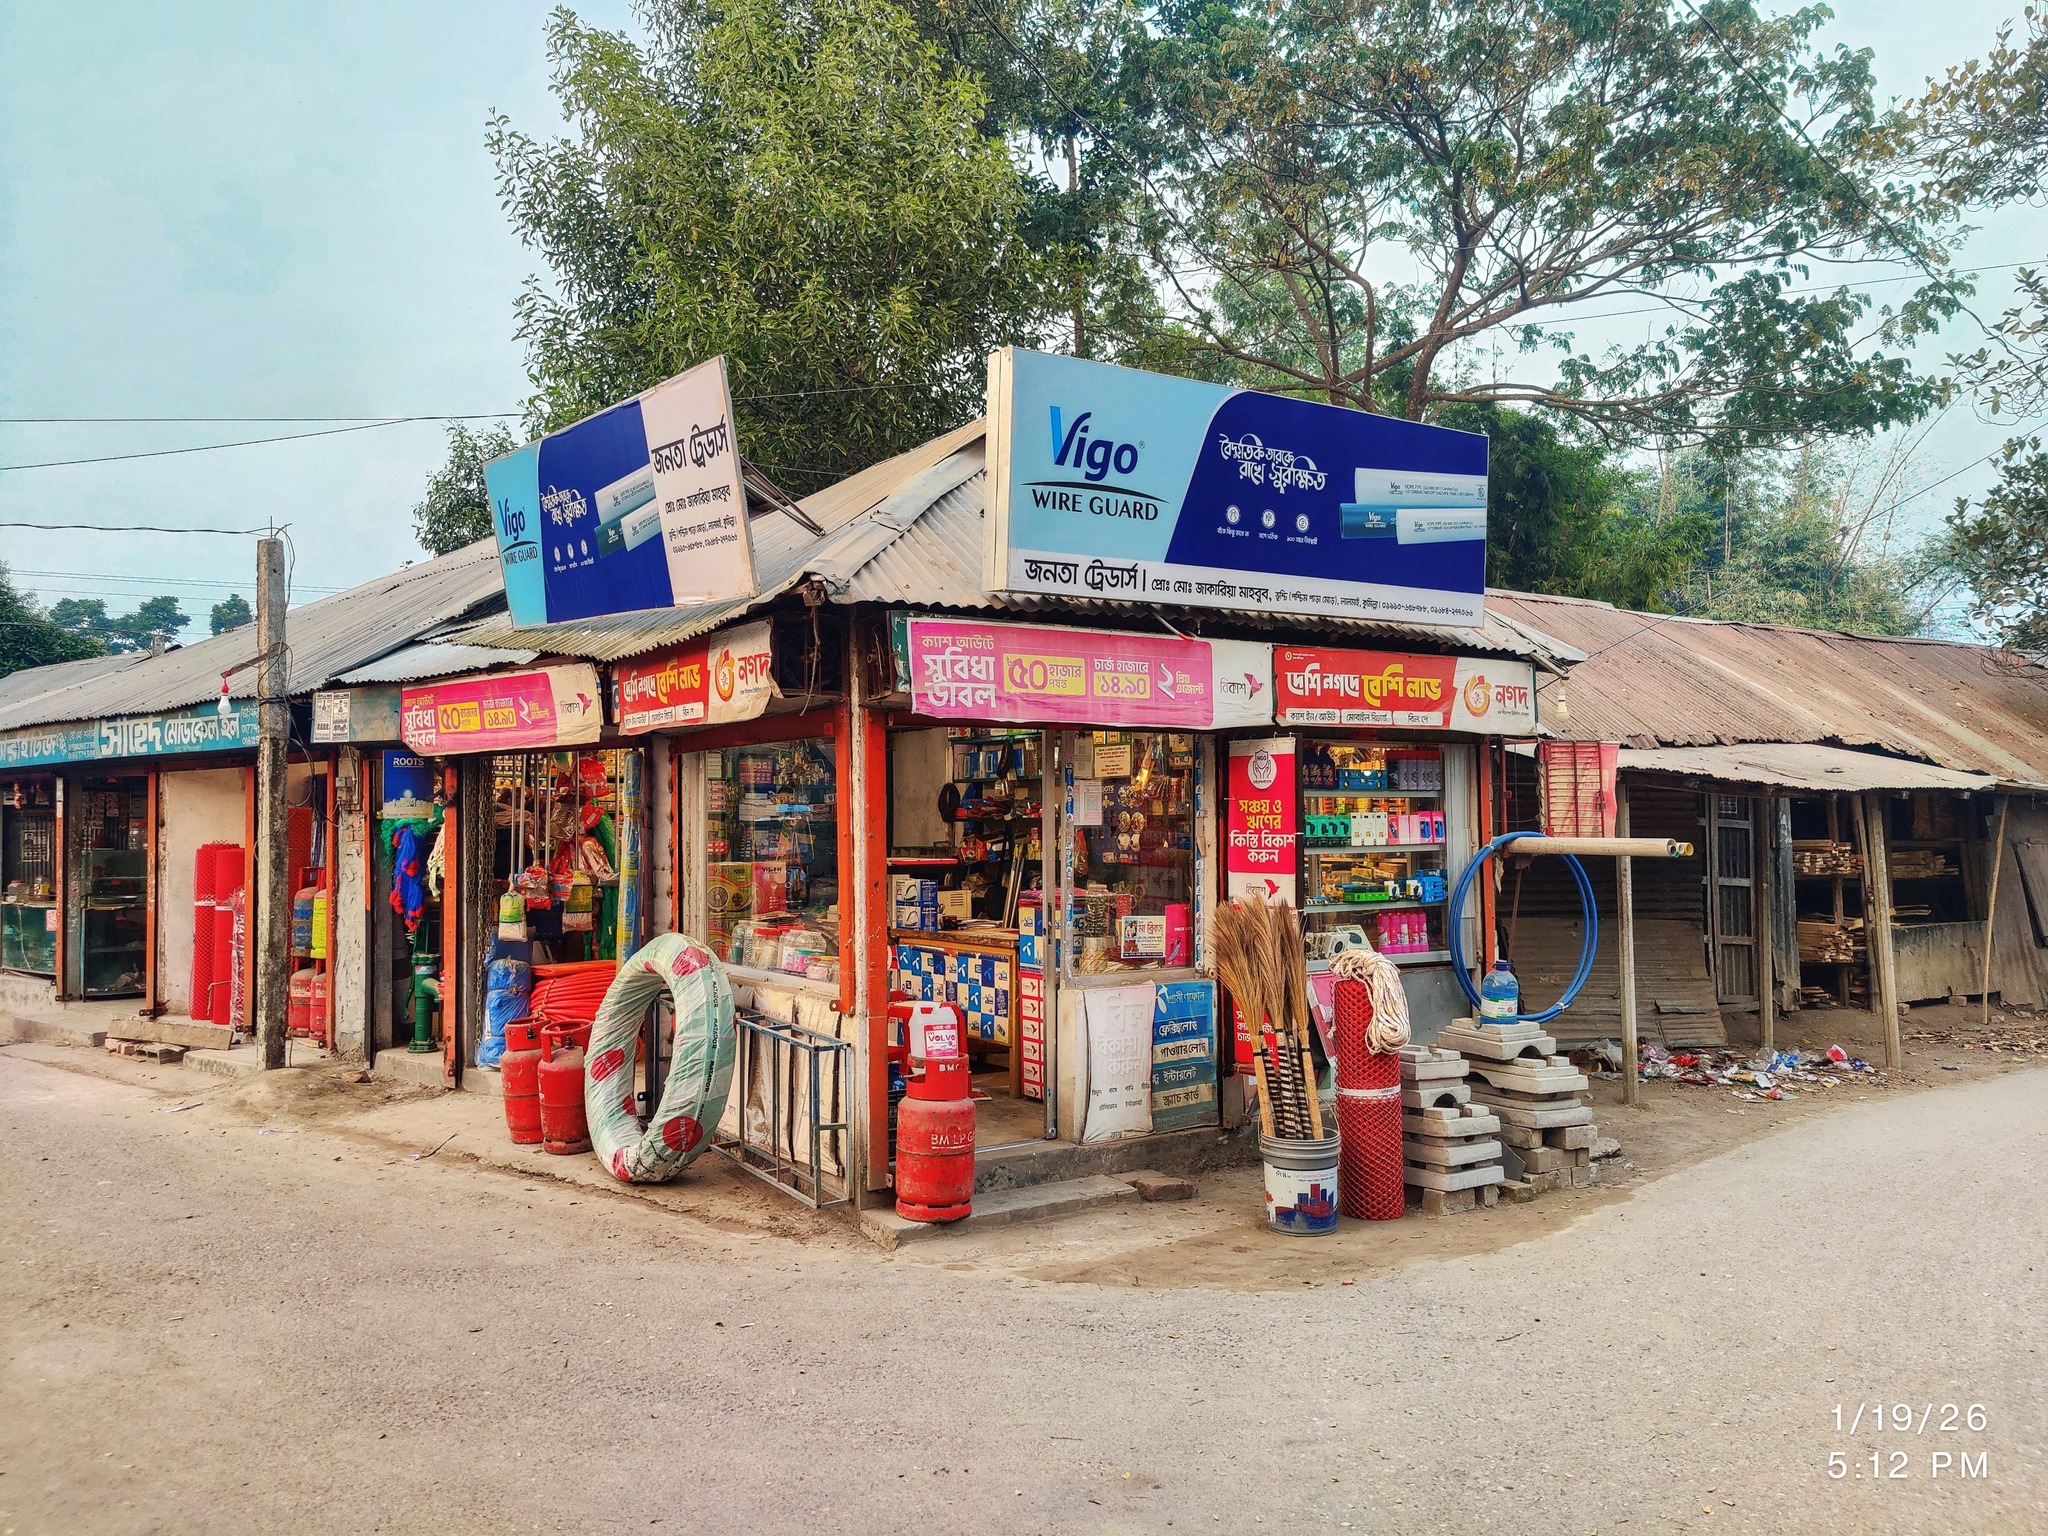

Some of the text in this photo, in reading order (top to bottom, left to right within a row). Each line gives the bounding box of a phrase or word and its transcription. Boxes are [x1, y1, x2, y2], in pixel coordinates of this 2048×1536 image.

[651, 413, 729, 475] জনতা ট্রেডার্স
[1050, 405, 1139, 482] Vigo
[1219, 433, 1294, 467] বৈদ্যুতিক তারকে
[1238, 455, 1328, 494] রাখে সুরক্ষিত
[1032, 489, 1159, 521] WIRE GUARD
[498, 497, 526, 541] Vigo
[504, 547, 538, 566] WIRE GUARD
[1024, 558, 1079, 585] জনতা
[1084, 559, 1139, 591] ট্রেডার্স
[1195, 580, 1237, 599] জাকারিয়া
[921, 634, 994, 649] ক্যাশ আউটে
[737, 652, 772, 685] নগদ
[922, 646, 995, 683] সুবিধা
[1049, 663, 1082, 678] হাজার
[1093, 658, 1149, 674] চার্জ হাজারে
[656, 656, 679, 704] বেশি
[679, 664, 701, 690] লাভ
[1157, 663, 1175, 700] ২
[1175, 671, 1190, 685] প্রিয়
[1220, 678, 1247, 695] বিকাশ
[1285, 662, 1442, 707] দেশি নগদে বেশি লাভ
[924, 682, 997, 708] ডাবল
[1175, 683, 1204, 695] এজেন্টে
[1495, 684, 1529, 710] নগদ
[518, 696, 532, 725] ২
[560, 699, 580, 715] বিকাশ
[1290, 711, 1305, 721] ক্যাশ
[404, 704, 435, 732] সুবিধা
[1346, 711, 1370, 722] মোবাইল
[1407, 713, 1419, 723] বিল
[101, 715, 162, 756] সাহেদ
[164, 711, 219, 746] মেডিকেল
[219, 713, 240, 741] হল
[393, 757, 425, 766] ROOTS
[1238, 799, 1283, 814] সঞ্চয় ও
[1246, 814, 1283, 830] ঋণের
[1229, 829, 1296, 849] কিস্তি বিকাশ
[1247, 849, 1279, 863] করুন
[1138, 924, 1146, 933] মা
[1168, 991, 1205, 1005] গ্রামীণফোন
[1107, 995, 1151, 1032] বিল
[928, 1034, 956, 1042] VOLVO
[1095, 1037, 1138, 1056] বিকাশ
[939, 1063, 955, 1072] BM
[1108, 1058, 1145, 1074] করুন
[1163, 1066, 1197, 1084] ইন্টারনেট
[704, 1060, 714, 1093] MATADOR
[1183, 1087, 1200, 1101] কার্ড
[931, 1133, 950, 1145] BM
